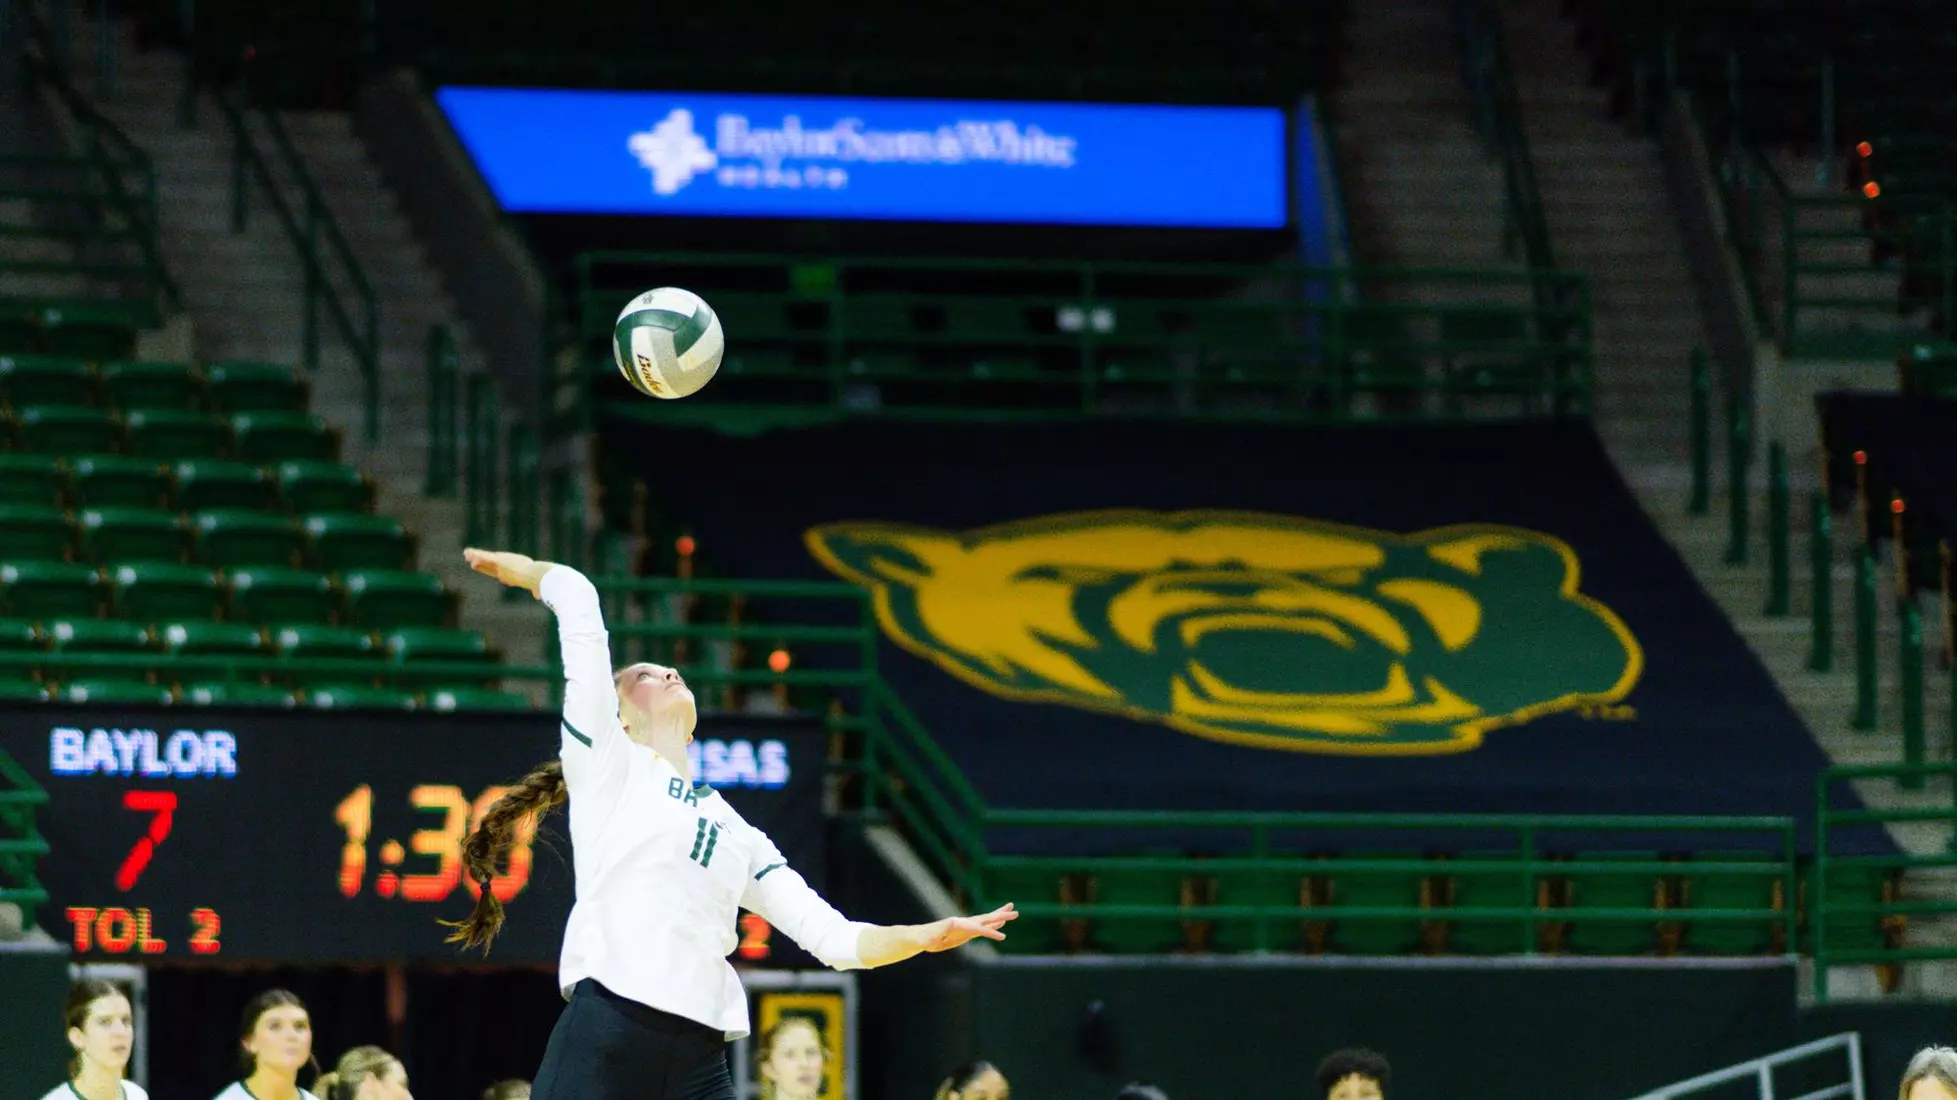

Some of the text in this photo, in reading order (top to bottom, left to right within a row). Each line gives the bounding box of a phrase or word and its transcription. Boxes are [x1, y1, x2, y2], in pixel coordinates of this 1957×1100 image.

[50, 727, 238, 777] BAYLOR
[116, 790, 178, 891] 7
[689, 816, 719, 868] 11
[66, 907, 220, 953] TOL 2
[738, 913, 771, 960] 2
